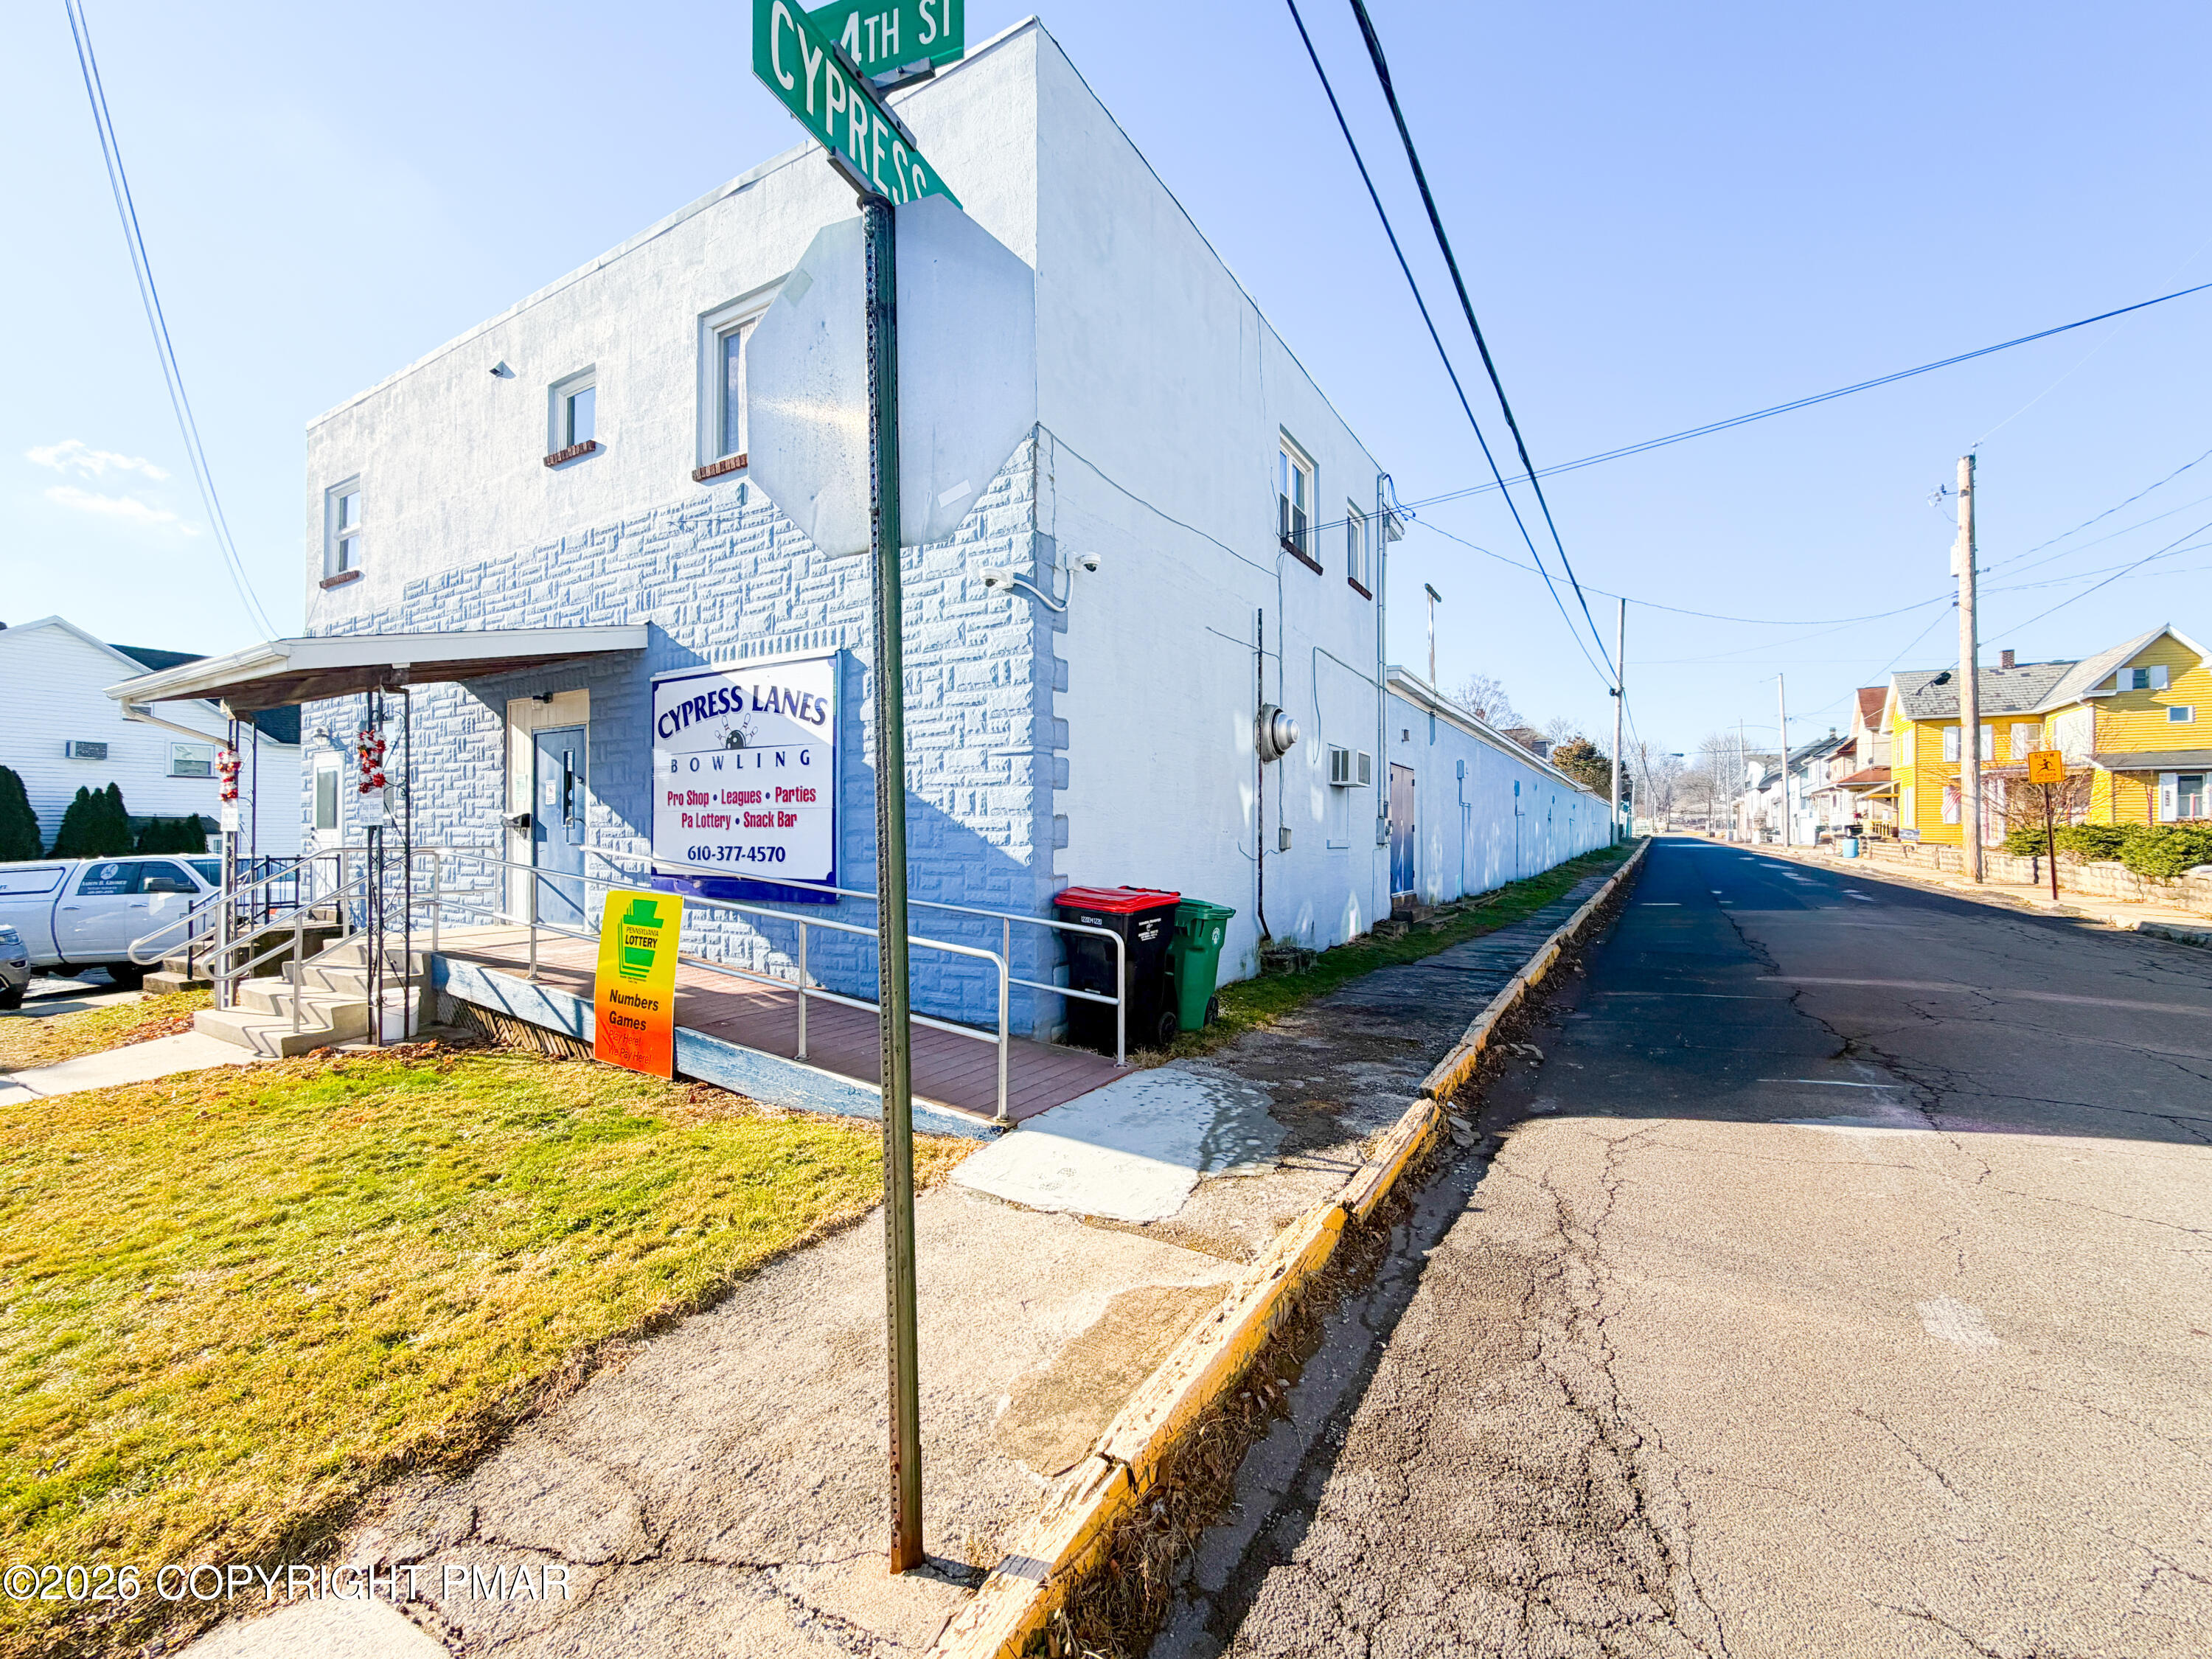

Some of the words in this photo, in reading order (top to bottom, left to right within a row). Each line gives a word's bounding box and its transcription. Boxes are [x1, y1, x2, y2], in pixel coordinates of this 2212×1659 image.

[839, 7, 900, 66] 4TH
[658, 685, 744, 740] CYPRESS
[752, 684, 829, 726] LANES
[670, 749, 811, 773] BOWLING
[667, 790, 684, 806] Pro
[686, 790, 709, 807] Shop
[721, 788, 762, 807] Leagues
[775, 785, 816, 803] Parties
[681, 813, 693, 828] Pa
[696, 812, 731, 830] Lottery
[743, 811, 774, 828] Snack
[777, 810, 797, 827] Bar
[687, 845, 786, 863] 610-377-4570
[625, 933, 658, 949] LOTTERY
[626, 926, 659, 937] PENNSYLVANIA
[609, 989, 659, 1012] Numbers
[609, 1010, 647, 1032] Games
[609, 1029, 622, 1044] Play
[623, 1033, 641, 1047] Here!
[608, 1044, 619, 1056] We
[619, 1047, 633, 1062] Pay
[633, 1051, 652, 1064] Here!
